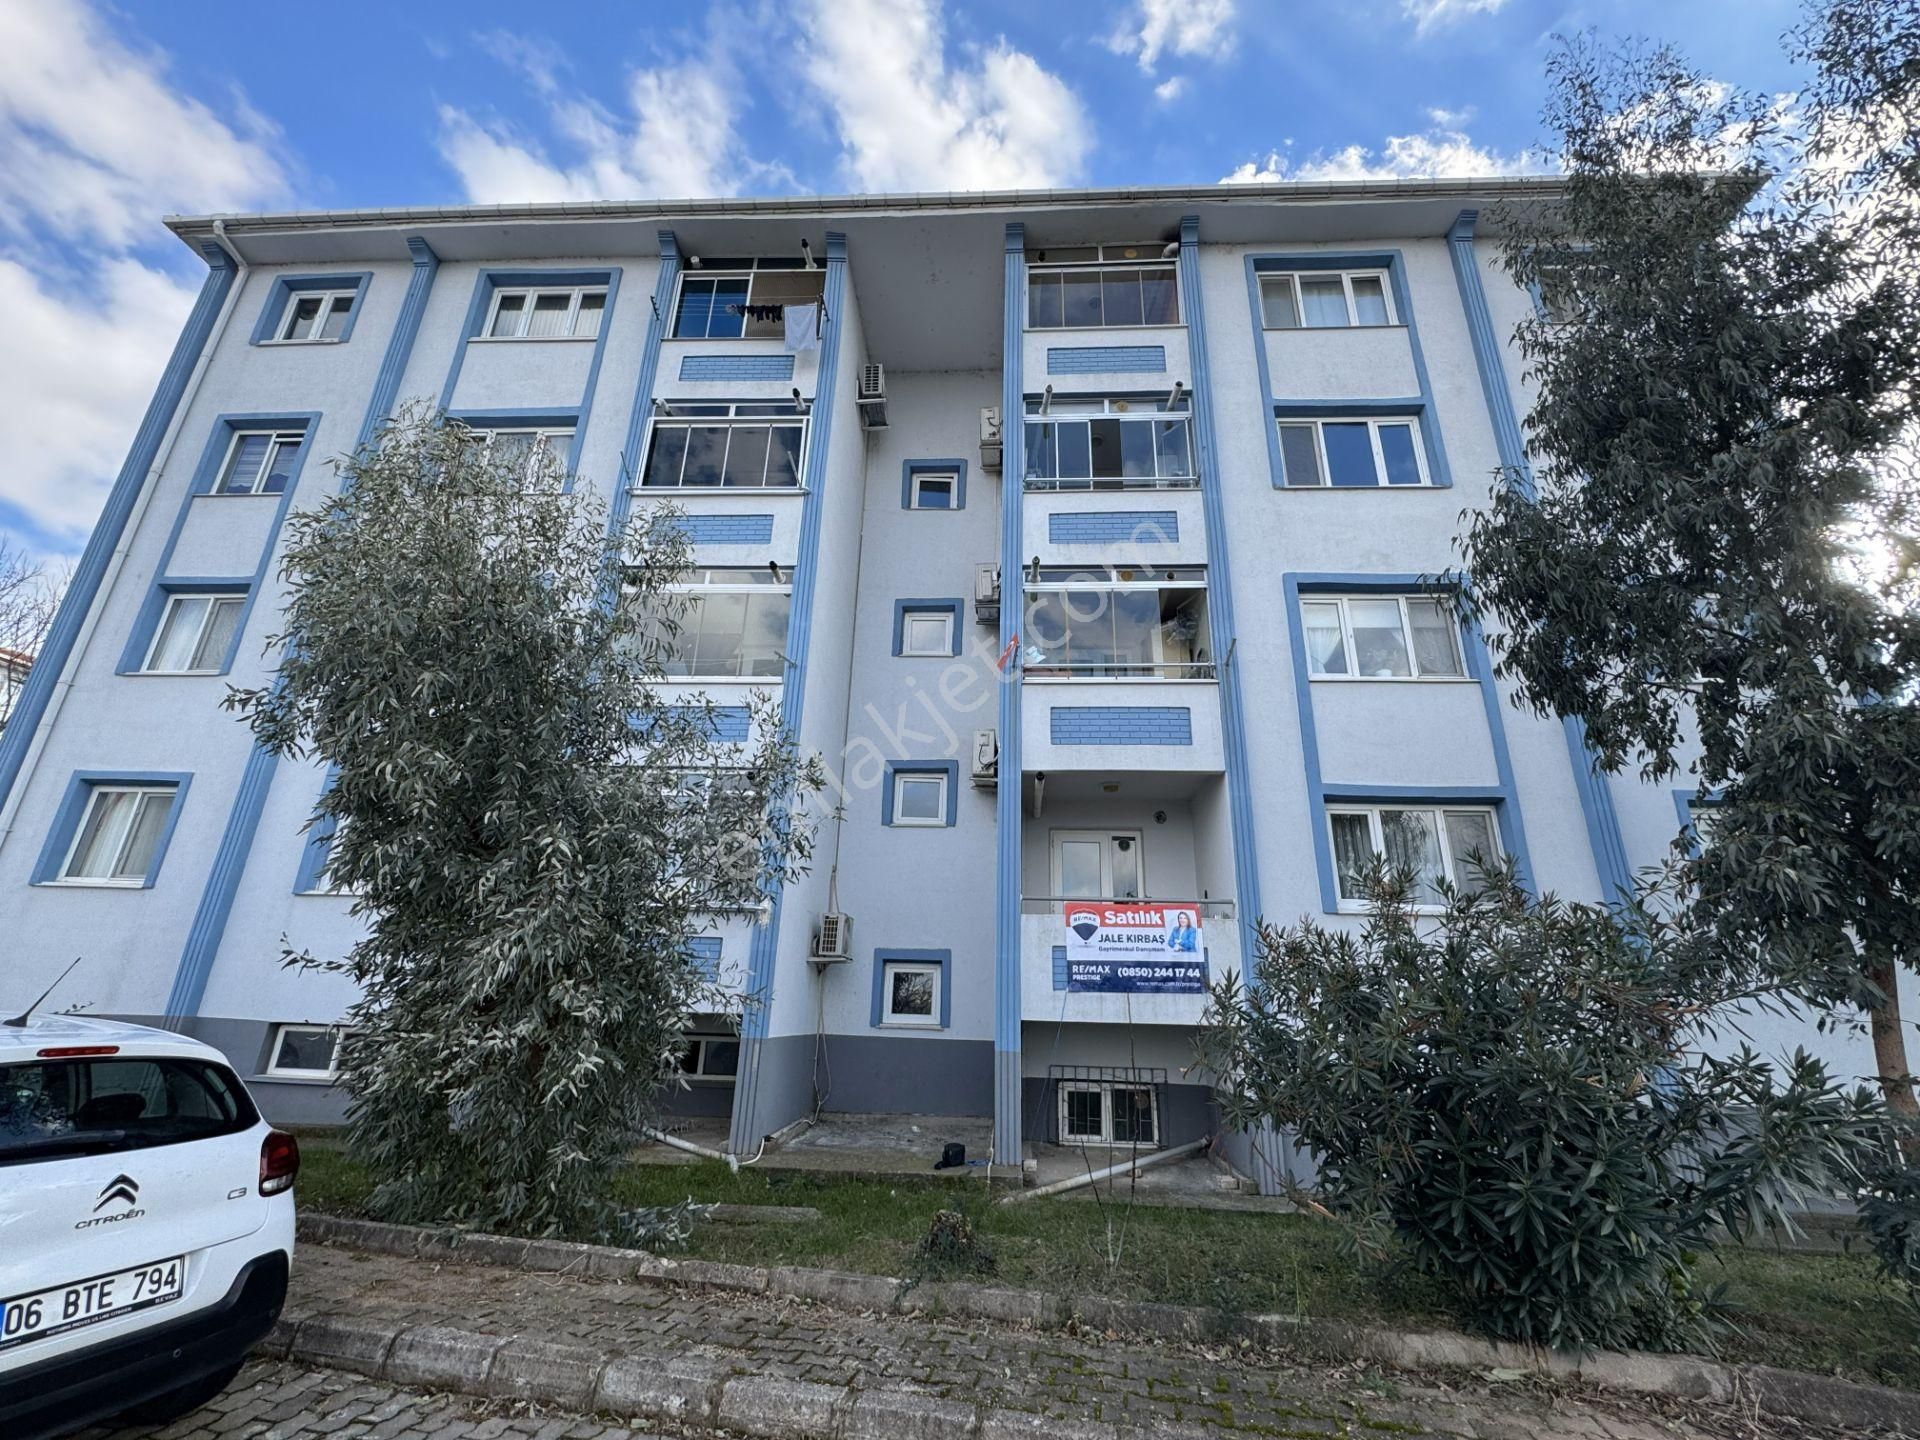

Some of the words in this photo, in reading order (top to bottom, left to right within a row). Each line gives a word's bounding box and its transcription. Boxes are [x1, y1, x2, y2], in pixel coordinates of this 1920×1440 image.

[1105, 910, 1162, 925] Satılık
[1098, 934, 1124, 943] JALE
[1126, 934, 1166, 945] KIRBAŞ
[1072, 965, 1110, 974] RE/MAX
[1117, 967, 1152, 978] (0850)
[1153, 968, 1174, 977] 244
[1174, 968, 1185, 977] 17
[1185, 968, 1201, 978] 44
[227, 1187, 248, 1200] C3
[4, 1298, 44, 1336] 06
[62, 1279, 116, 1320] BTE
[132, 1263, 178, 1301] 794
